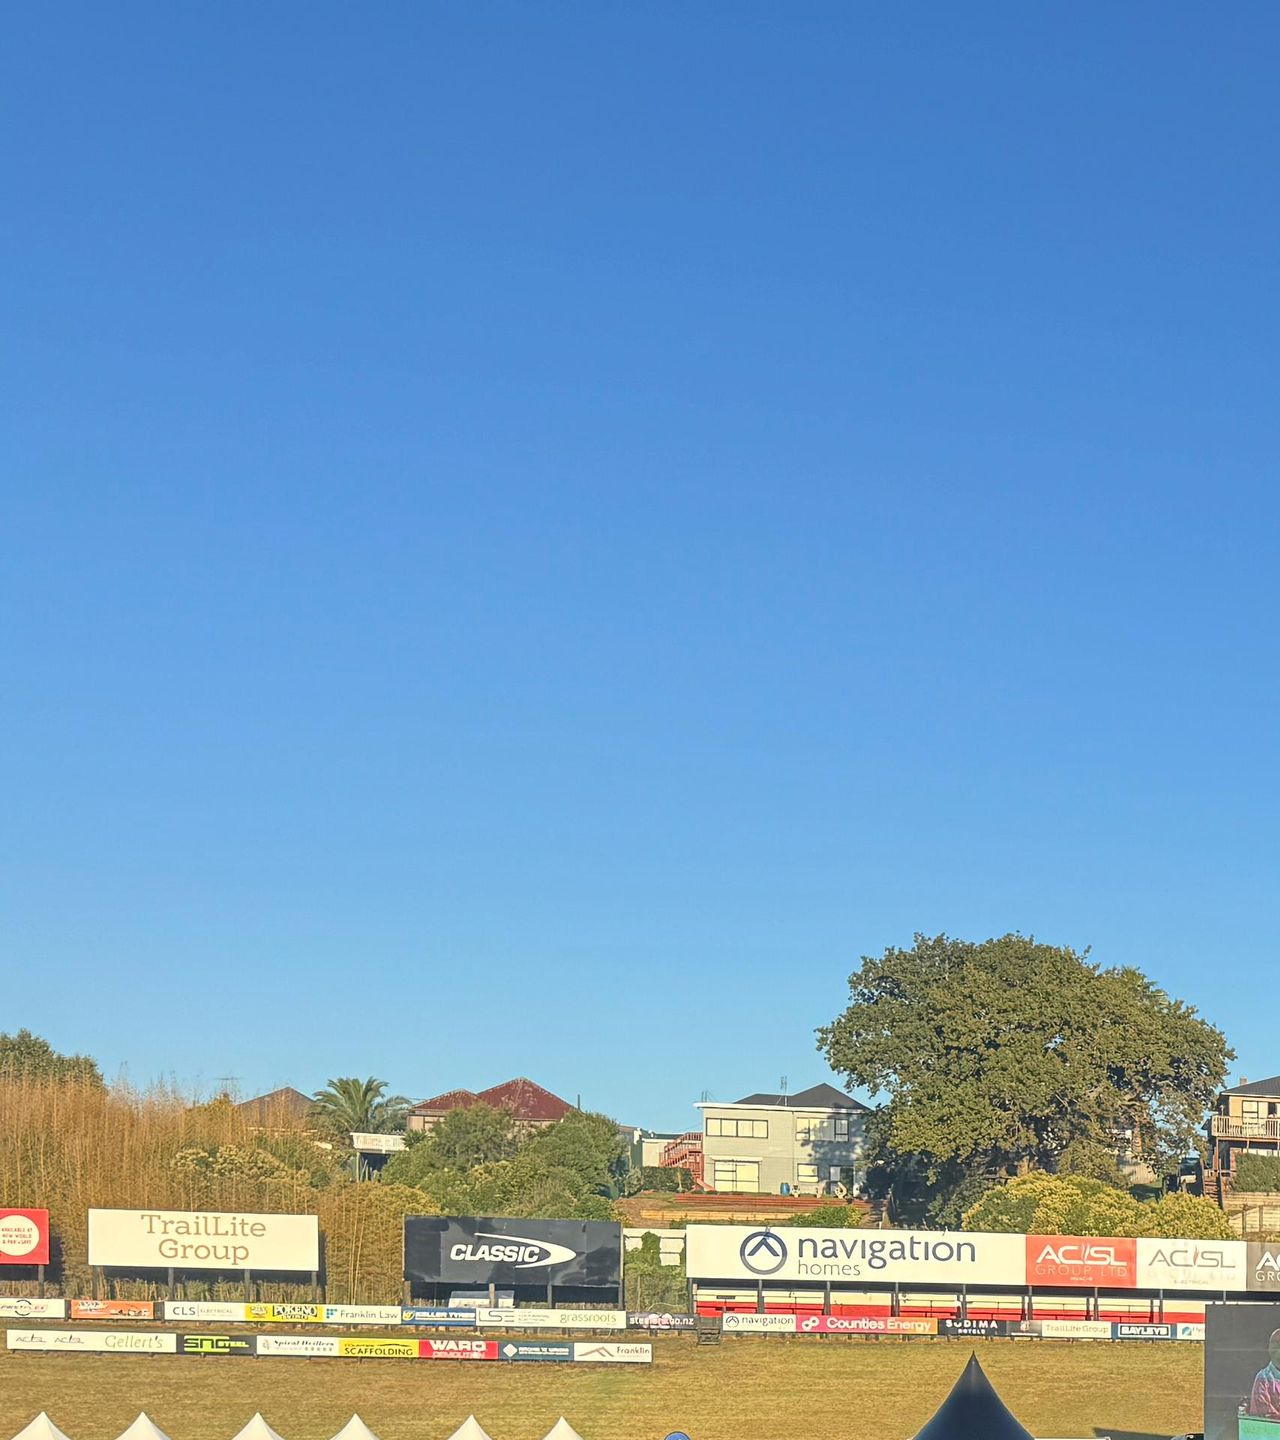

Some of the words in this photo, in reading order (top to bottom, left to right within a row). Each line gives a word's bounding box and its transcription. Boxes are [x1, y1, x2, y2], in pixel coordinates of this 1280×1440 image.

[141, 1214, 266, 1237] TrailLite
[158, 1238, 249, 1265] Group
[450, 1244, 539, 1263] CLASSIC
[799, 1235, 976, 1269] navigation
[798, 1259, 861, 1276] homes
[1035, 1264, 1092, 1276] GROUP
[1101, 1265, 1128, 1277] LTD
[173, 1307, 196, 1316] CLS
[273, 1305, 317, 1316] POKENO
[340, 1307, 376, 1318] Franklin
[380, 1308, 398, 1318] Law
[560, 1312, 617, 1325] grassroots
[742, 1314, 794, 1326] navigation
[946, 1319, 998, 1329] SUDIMA
[827, 1318, 885, 1330] Counties
[887, 1319, 932, 1332] Energy
[1045, 1324, 1081, 1333] TrailLite
[1082, 1325, 1109, 1335] Group
[1121, 1326, 1169, 1336] BAYLEYS
[105, 1334, 163, 1348] Gellert's
[345, 1347, 413, 1356] SCAFFOLDING
[617, 1347, 650, 1355] Franklin
